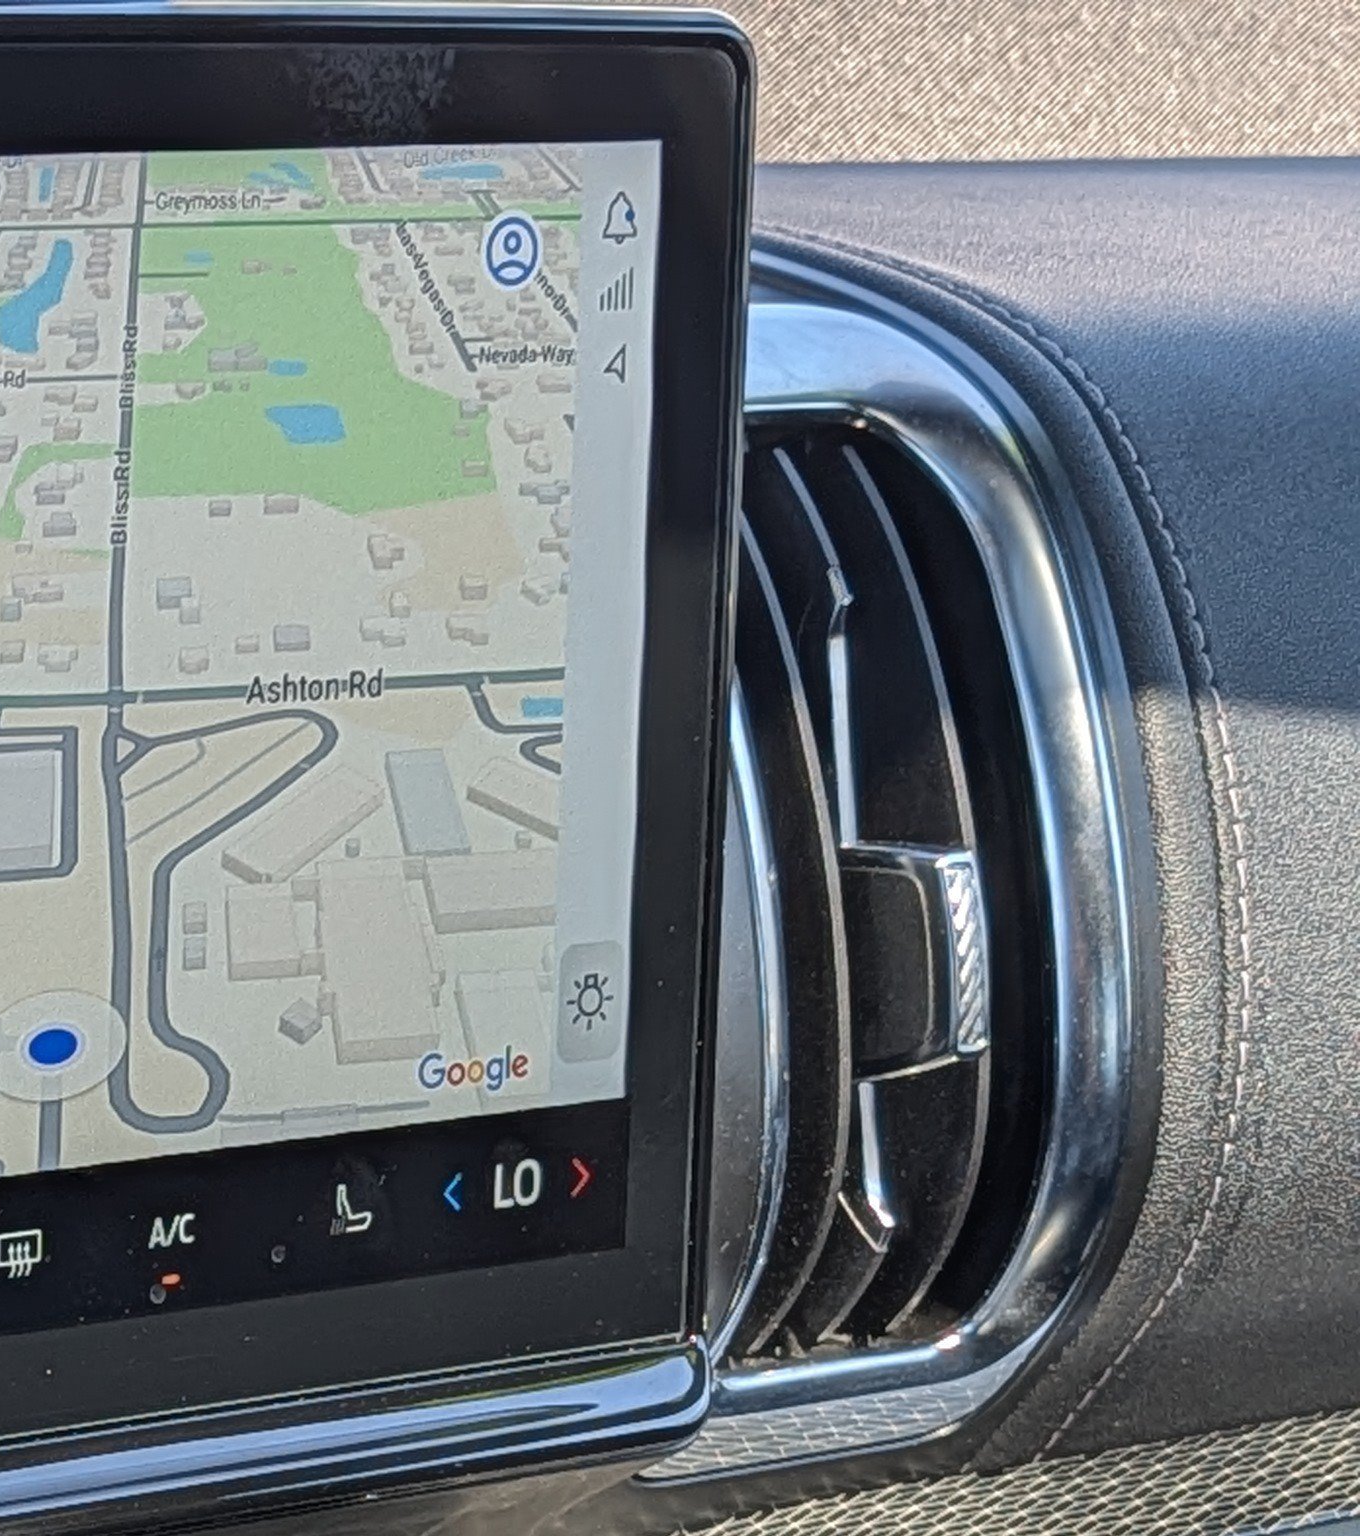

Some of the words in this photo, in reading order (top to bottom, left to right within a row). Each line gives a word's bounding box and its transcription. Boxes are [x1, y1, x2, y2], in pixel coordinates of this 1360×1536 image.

[155, 191, 238, 216] Greymoss
[241, 191, 262, 210] Ln
[122, 322, 139, 352] Rd
[480, 346, 538, 364] Nevada
[3, 369, 27, 389] Rd
[118, 353, 138, 410] Bliss
[113, 450, 132, 482] Rd
[110, 481, 131, 545] Bliss
[245, 675, 341, 704] Ashton
[347, 668, 384, 699] Rd
[416, 1044, 530, 1092] Google
[493, 1157, 542, 1210] LO
[148, 1212, 196, 1250] A/C
